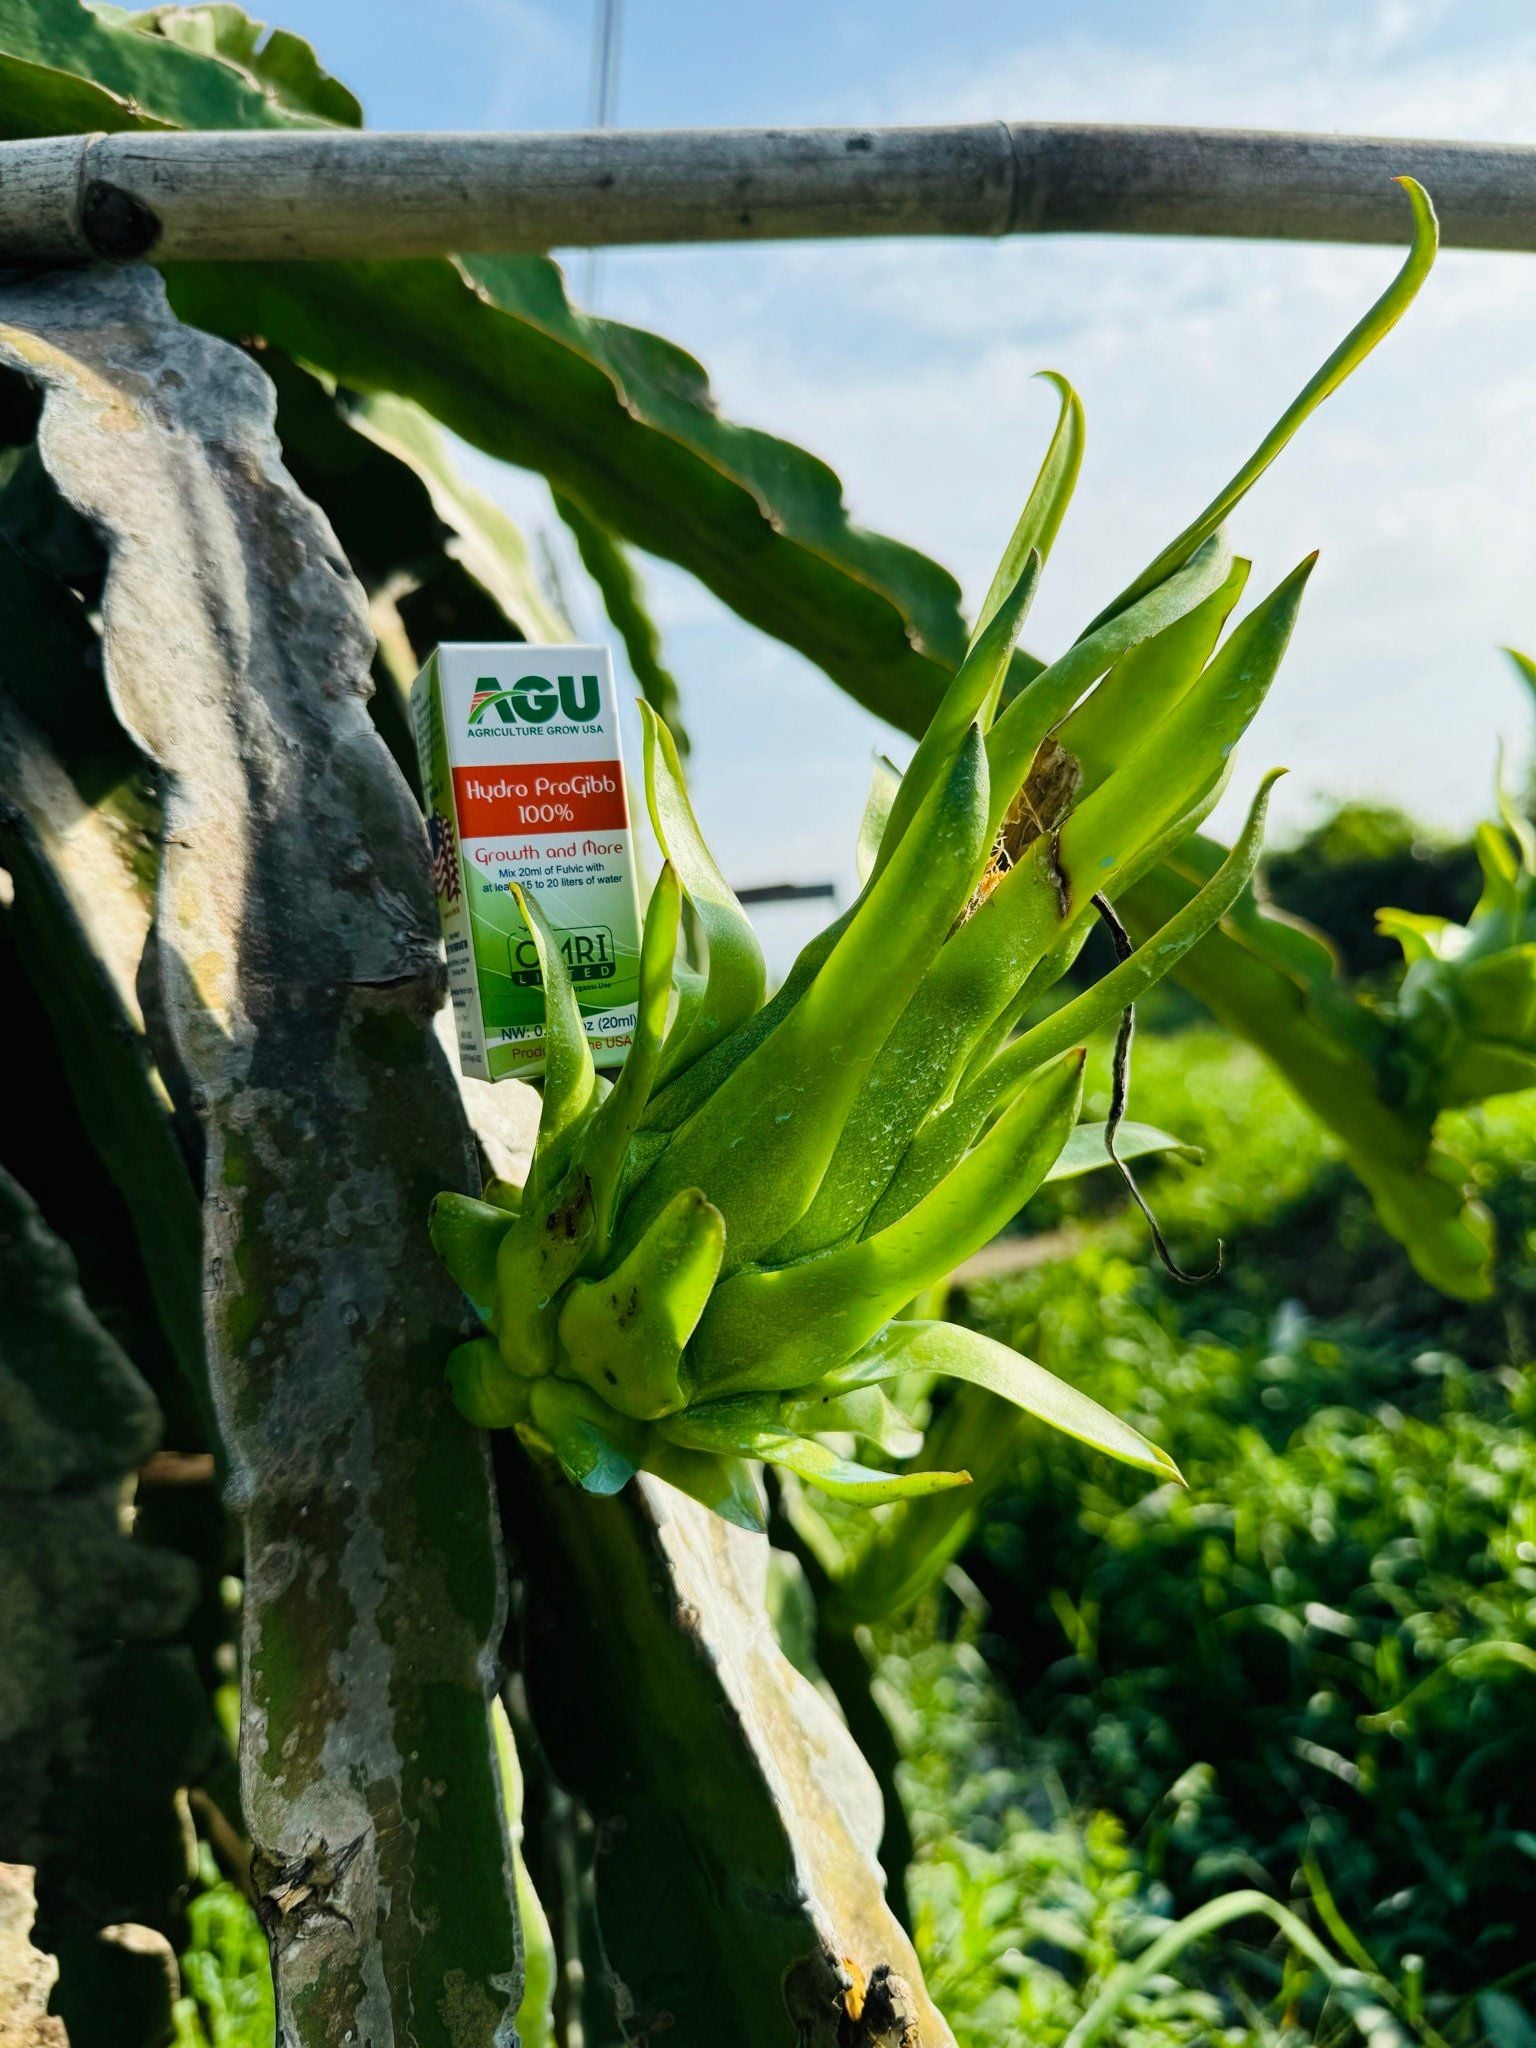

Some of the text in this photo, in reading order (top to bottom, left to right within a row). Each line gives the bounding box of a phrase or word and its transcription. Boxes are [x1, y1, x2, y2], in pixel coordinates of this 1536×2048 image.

[467, 675, 601, 725] AGU
[467, 724, 604, 738] AGRICULTURE GROW USA
[466, 774, 617, 803] Hydro ProGibb
[518, 803, 574, 824] 100%
[475, 839, 624, 866] Growth and More
[499, 863, 605, 878] Mix 20ml of Fulvic with
[482, 884, 493, 893] at
[535, 880, 545, 889] to
[547, 878, 559, 888] 20
[561, 876, 584, 887] liters
[586, 875, 595, 885] of
[596, 874, 623, 884] water
[519, 966, 610, 985] LIED
[501, 1026, 531, 1041] NW:
[598, 1013, 637, 1033] (20ml)
[606, 1034, 633, 1049] USA
